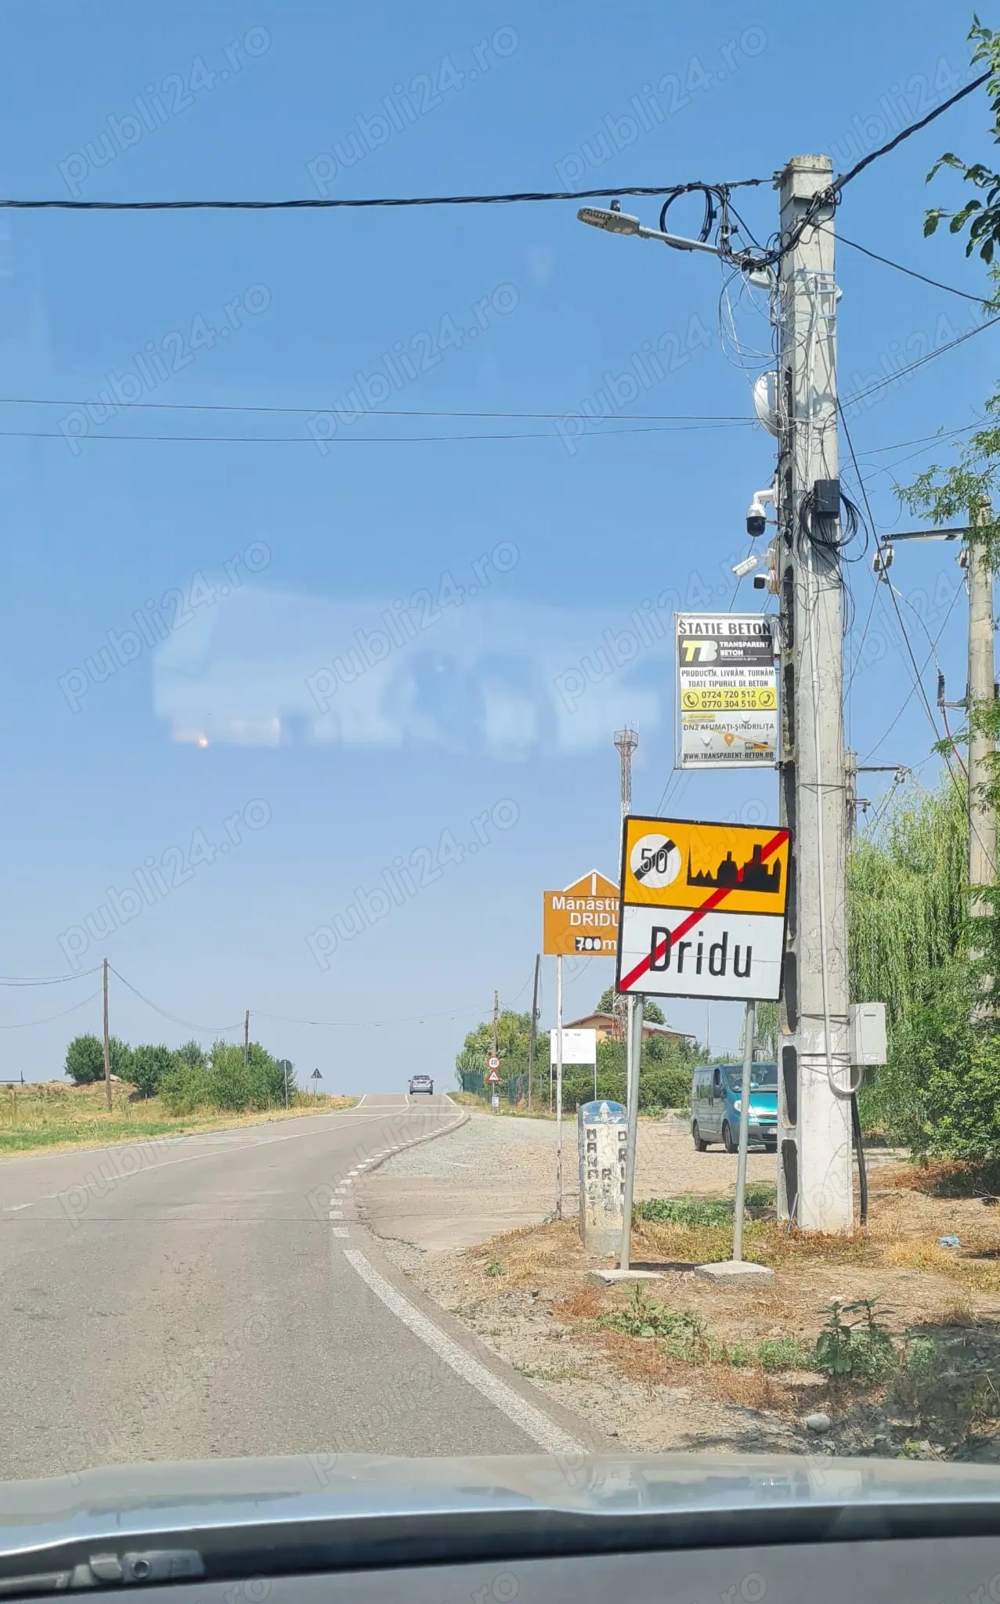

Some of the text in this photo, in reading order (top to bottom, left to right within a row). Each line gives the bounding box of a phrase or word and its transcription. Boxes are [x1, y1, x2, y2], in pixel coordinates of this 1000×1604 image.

[728, 622, 771, 635] BETON
[688, 680, 707, 688] TOATE
[709, 680, 737, 688] TIPURILE
[749, 679, 769, 687] BETON
[702, 691, 722, 699] 0724
[741, 690, 756, 698] 512
[702, 700, 757, 708] 0770 304 510
[640, 848, 668, 874] 50
[570, 912, 619, 927] DRIDU
[649, 925, 753, 978] Dridu
